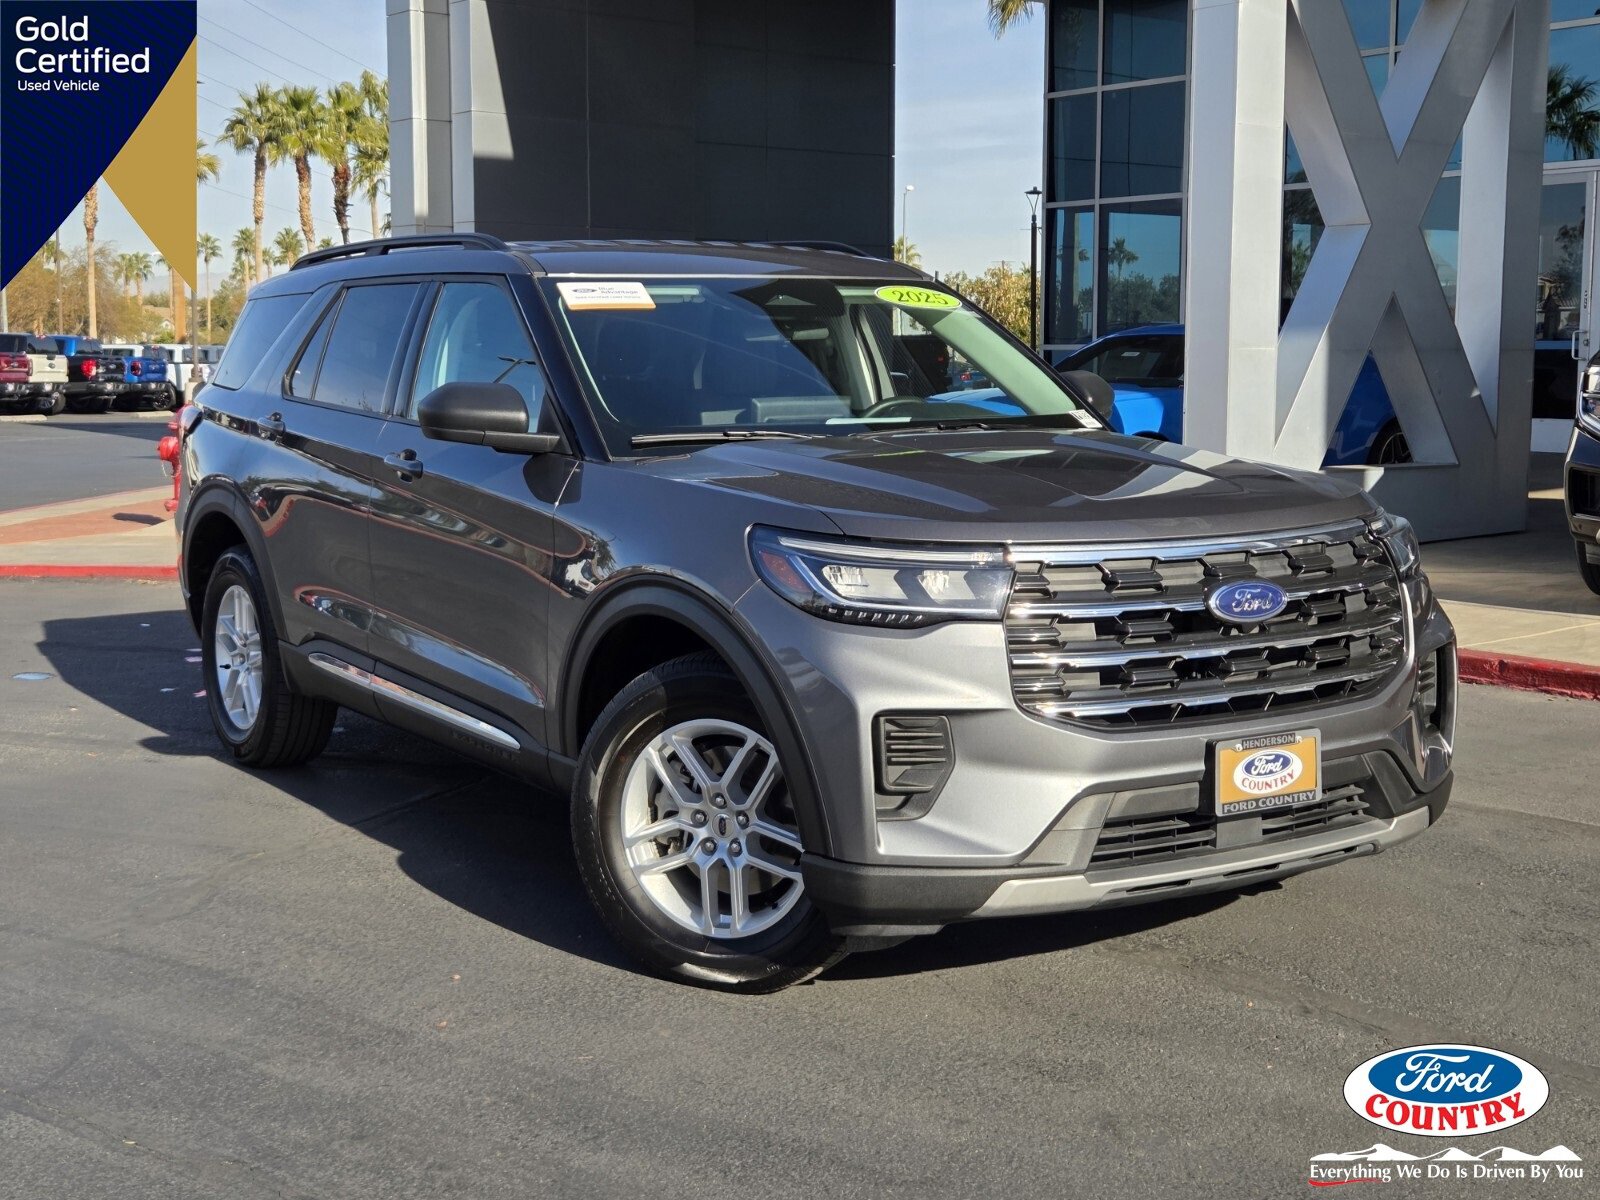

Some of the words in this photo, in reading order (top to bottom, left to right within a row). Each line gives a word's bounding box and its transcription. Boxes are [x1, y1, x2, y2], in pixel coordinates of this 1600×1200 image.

[891, 290, 948, 305] 2025
[1232, 588, 1273, 612] Ford
[1242, 734, 1295, 749] HENDERSON
[1251, 755, 1283, 776] Ford
[1241, 769, 1295, 791] COUNTRY
[1223, 800, 1256, 813] FORD
[1258, 791, 1315, 807] COUNTRY
